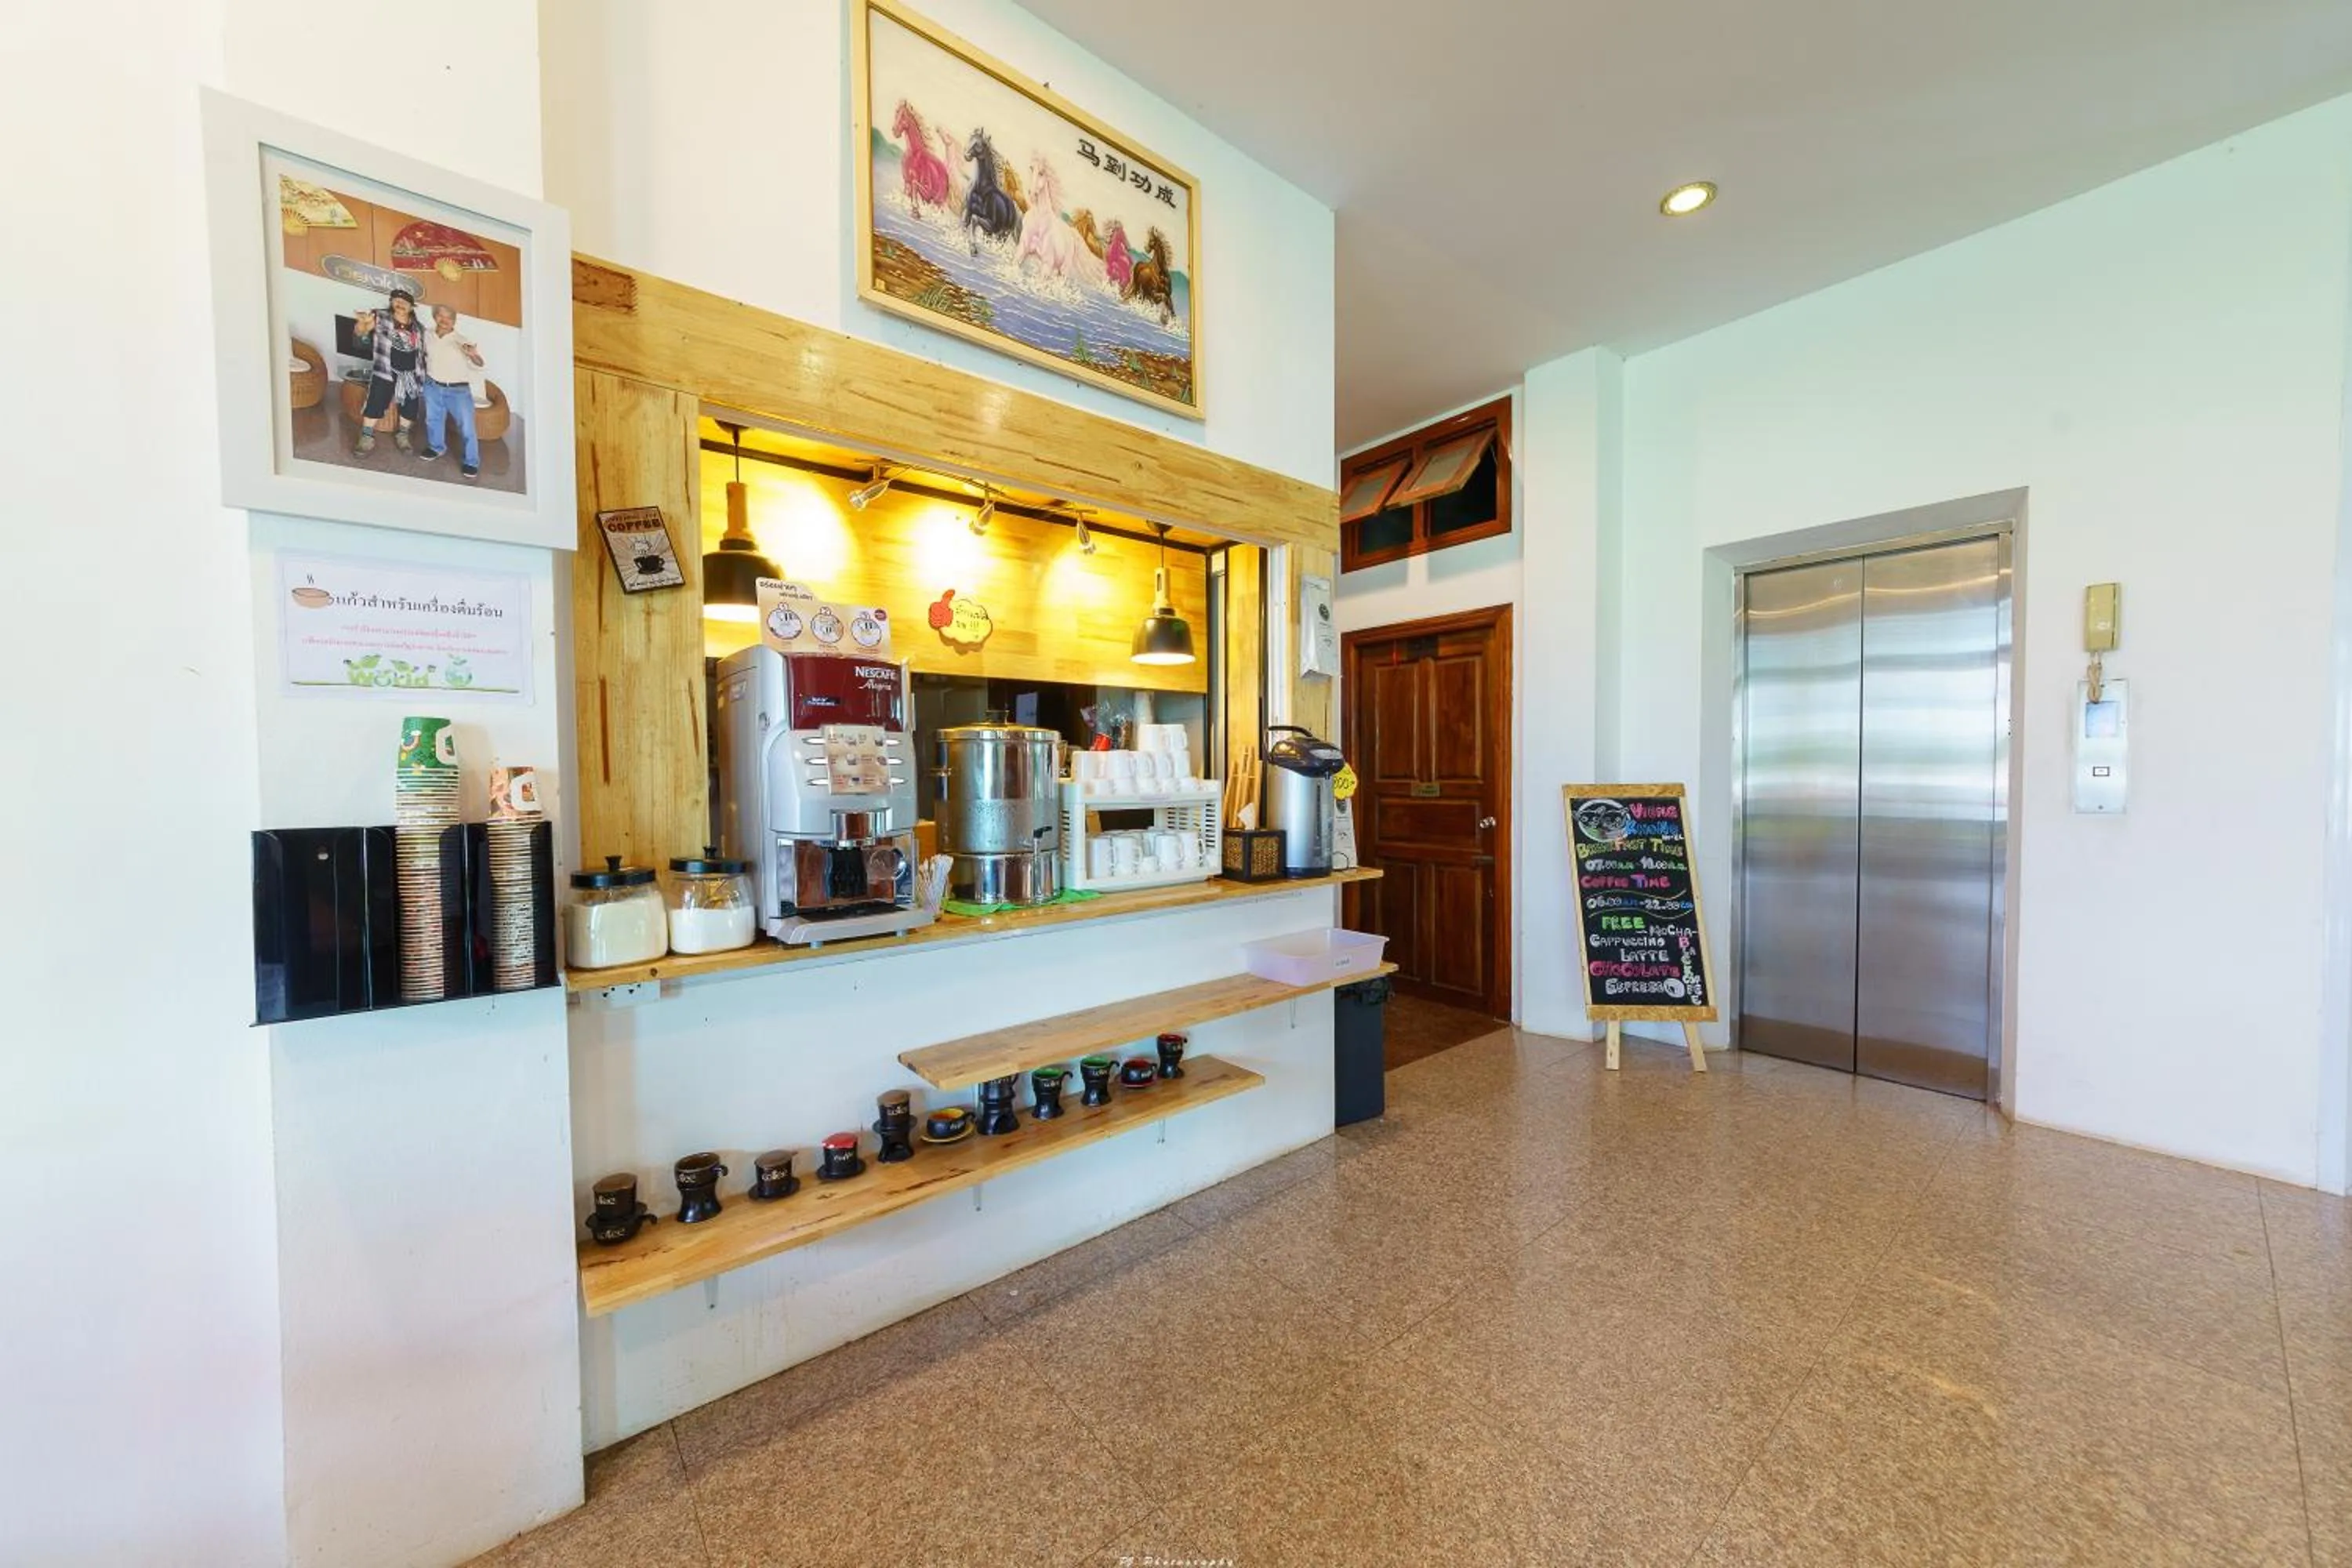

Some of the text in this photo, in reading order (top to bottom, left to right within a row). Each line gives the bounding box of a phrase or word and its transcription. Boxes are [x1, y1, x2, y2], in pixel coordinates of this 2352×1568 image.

[1076, 139, 1176, 209] 马到功成
[1580, 874, 1671, 888] COFFEE TIME
[1602, 916, 1645, 931] FREE
[1620, 948, 1669, 962] LATTE
